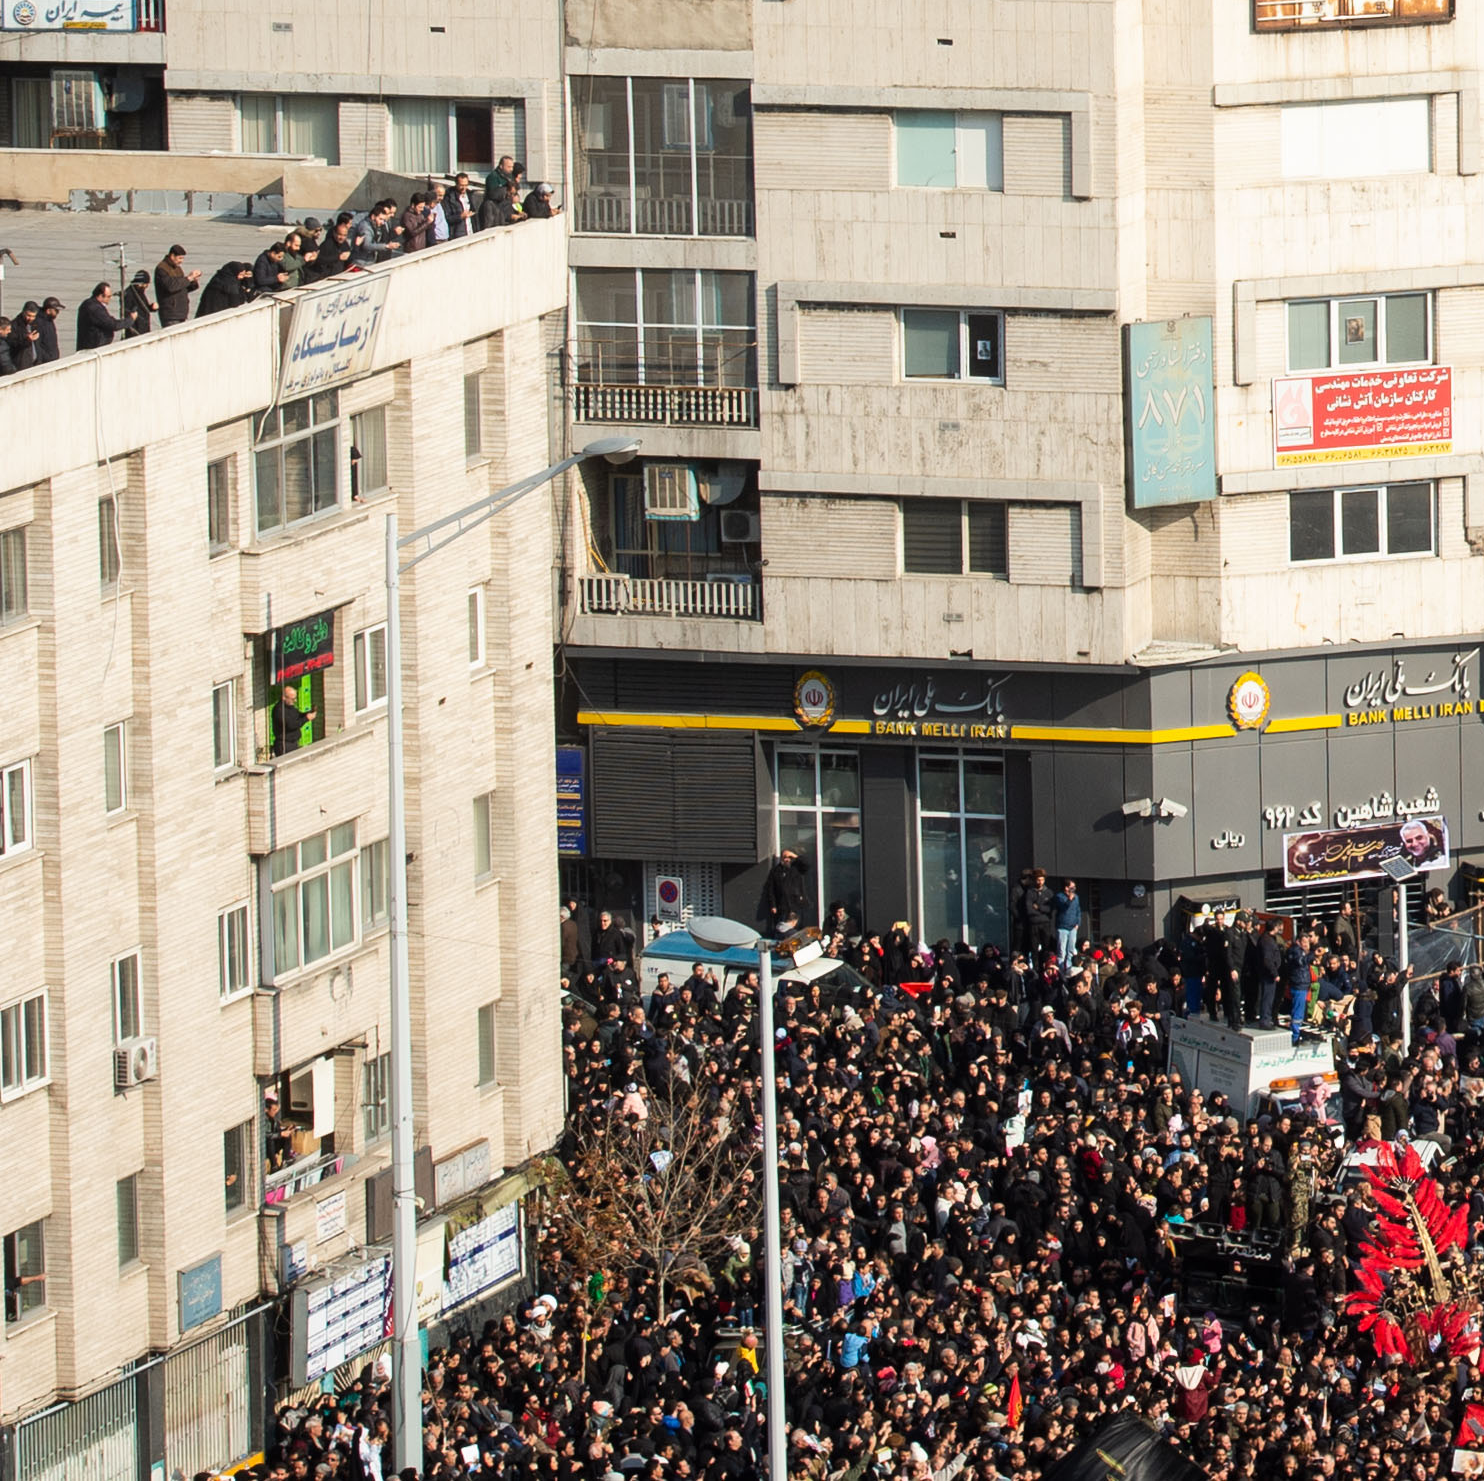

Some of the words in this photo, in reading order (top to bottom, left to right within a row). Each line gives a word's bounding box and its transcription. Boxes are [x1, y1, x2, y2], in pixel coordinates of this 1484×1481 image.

[45, 0, 77, 23] ایران
[81, 3, 124, 21] بیمه
[292, 305, 381, 362] آزمایشگاه
[1315, 377, 1350, 394] مهندسی
[1352, 375, 1381, 388] خدمات
[1383, 372, 1417, 389] تعاونی
[1419, 369, 1449, 385] شرکت
[1138, 382, 1206, 430] ۸۷۱
[1326, 396, 1352, 411] نشانی
[1353, 390, 1374, 410] آتش
[1374, 391, 1403, 408] سازمان
[1405, 389, 1437, 405] کارکنان
[1385, 661, 1405, 703] ملی
[1405, 647, 1480, 698] بانک
[873, 683, 915, 718] ایران
[913, 676, 936, 717] ملی
[935, 673, 1014, 722] بانک
[1346, 671, 1386, 707] ایران
[1349, 710, 1387, 725] BANK
[1393, 705, 1434, 720] MELLI
[1440, 701, 1473, 716] IRAN
[876, 722, 917, 735] BANK
[921, 723, 965, 737] MELLI
[970, 724, 1006, 738] IRAN
[1301, 802, 1322, 826] کد
[1337, 793, 1394, 829] شاهین
[1397, 787, 1440, 821] شعبه
[1214, 827, 1245, 849] ریالی
